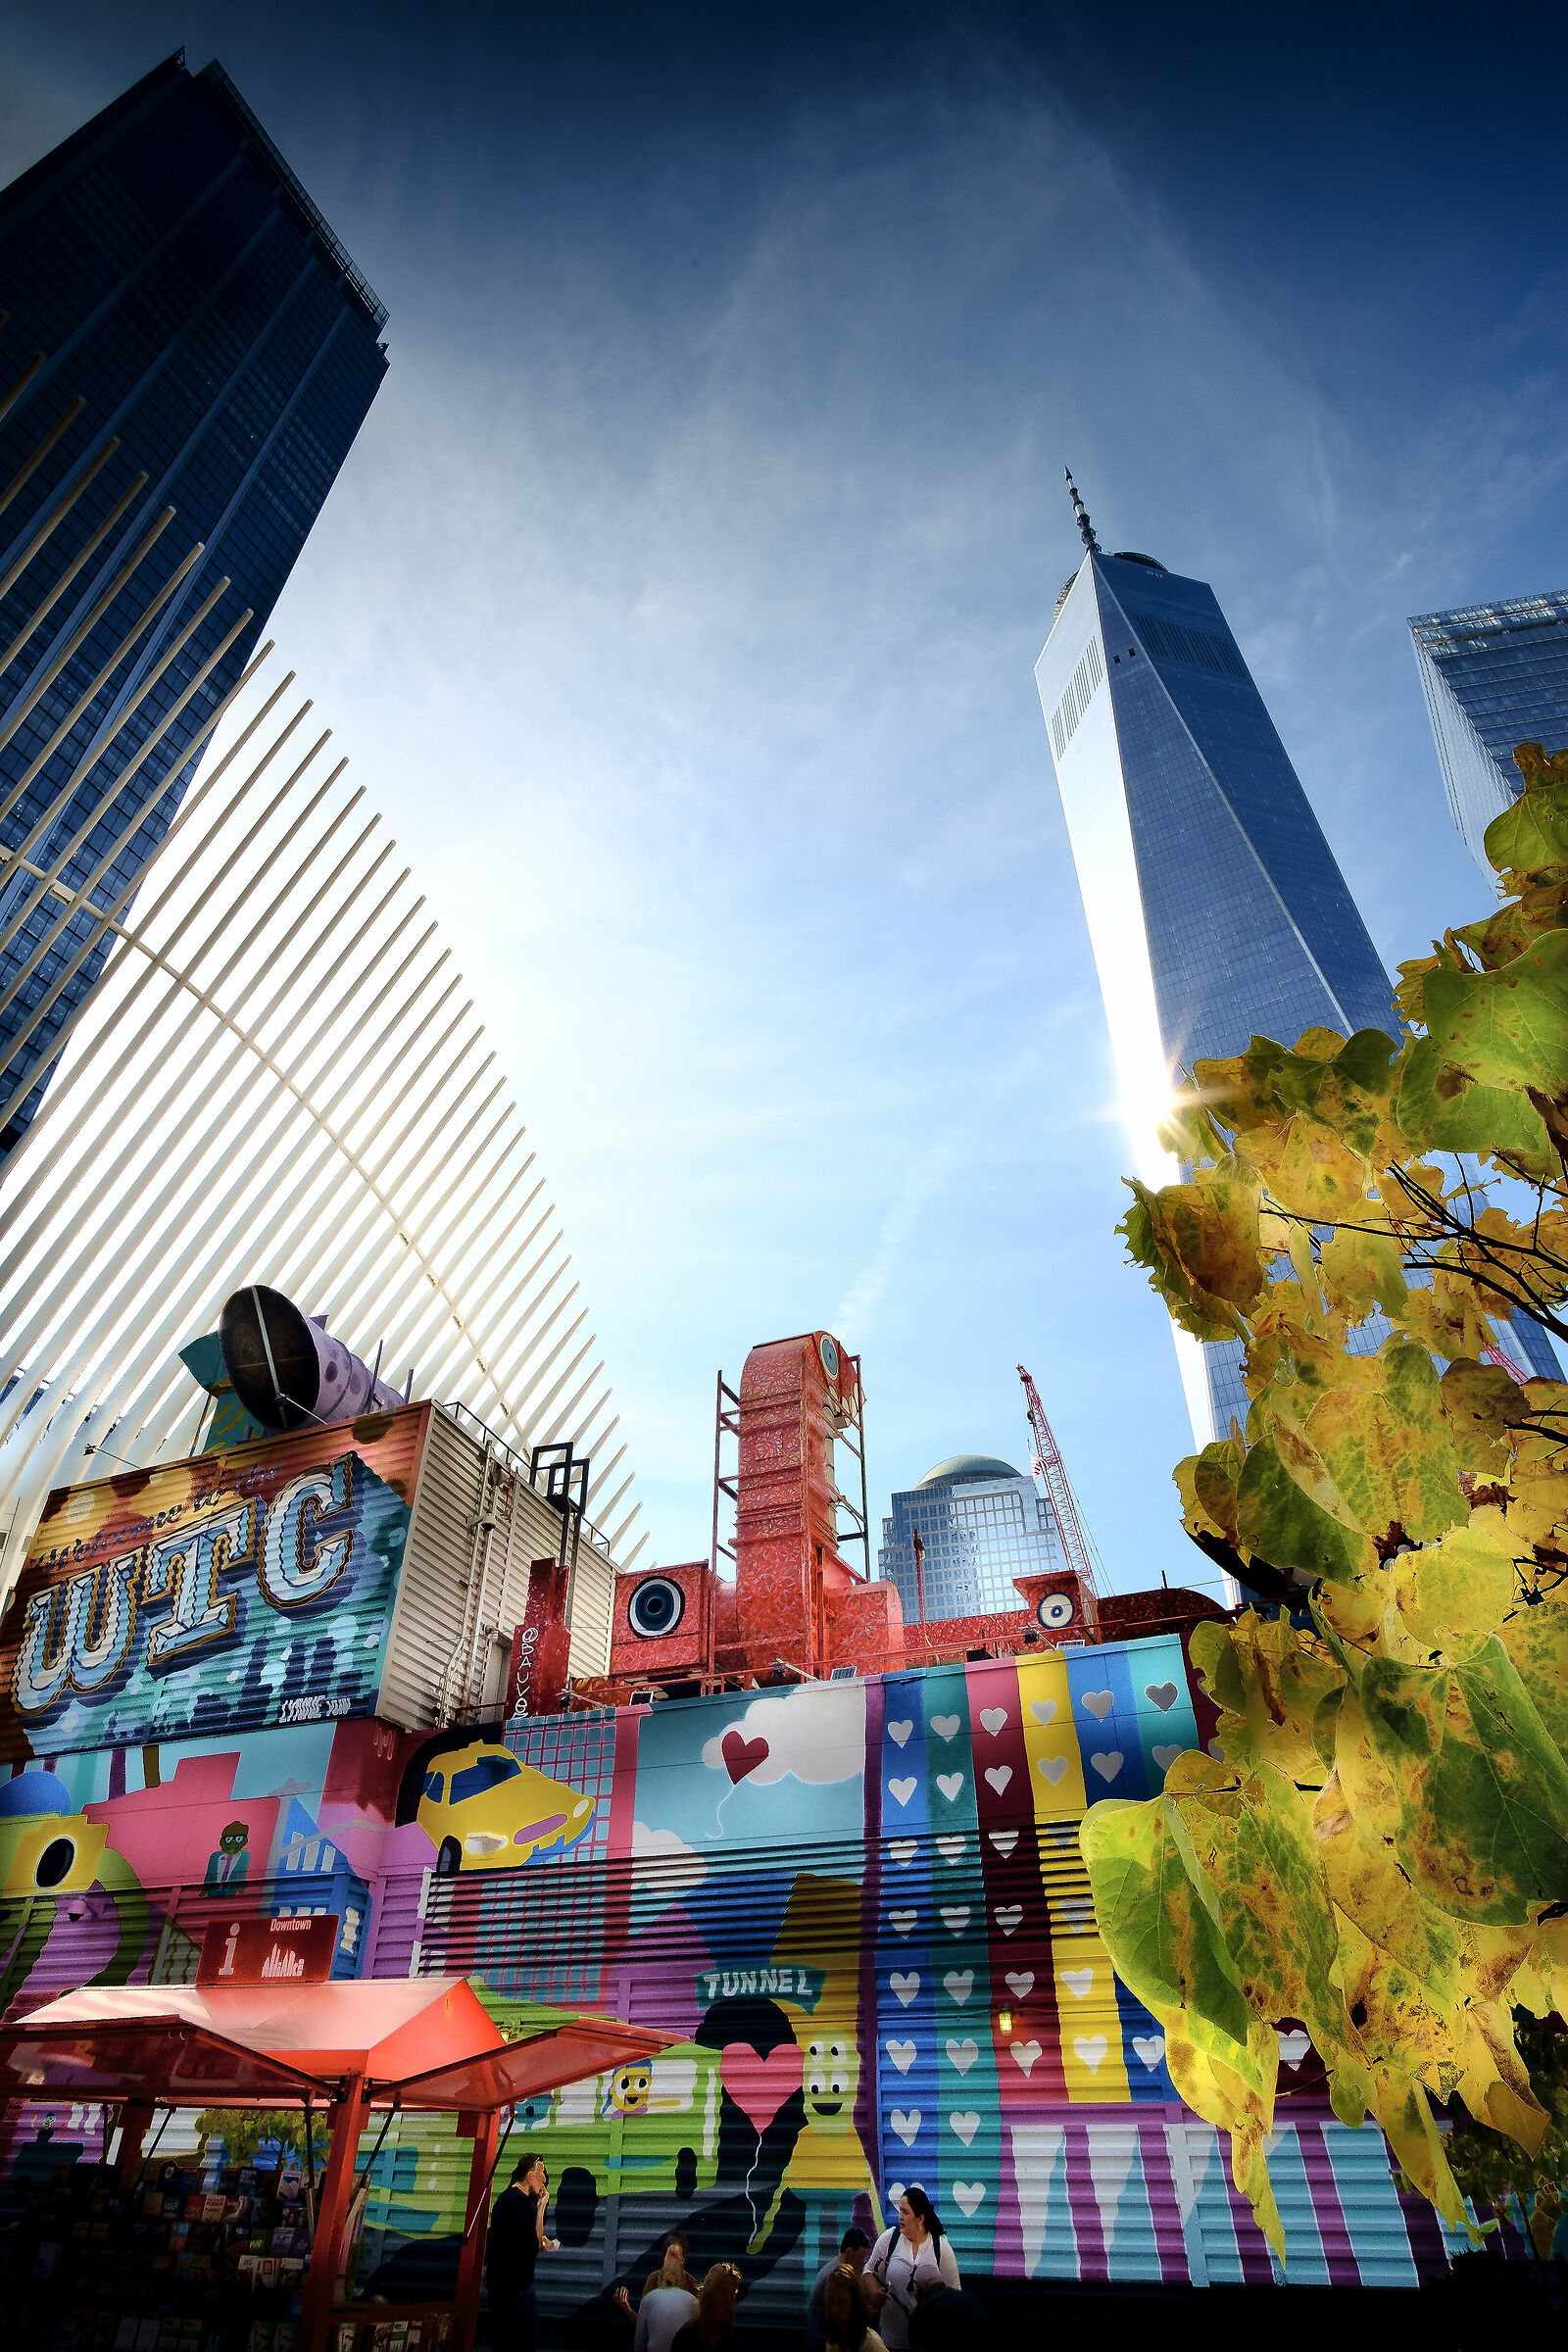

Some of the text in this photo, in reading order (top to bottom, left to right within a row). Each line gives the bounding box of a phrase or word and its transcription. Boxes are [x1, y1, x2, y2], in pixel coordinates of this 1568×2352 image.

[194, 1484, 226, 1512] to
[11, 1450, 359, 1718] WTC
[270, 1918, 312, 1932] Downtown
[703, 1969, 813, 1999] TUNNEL
